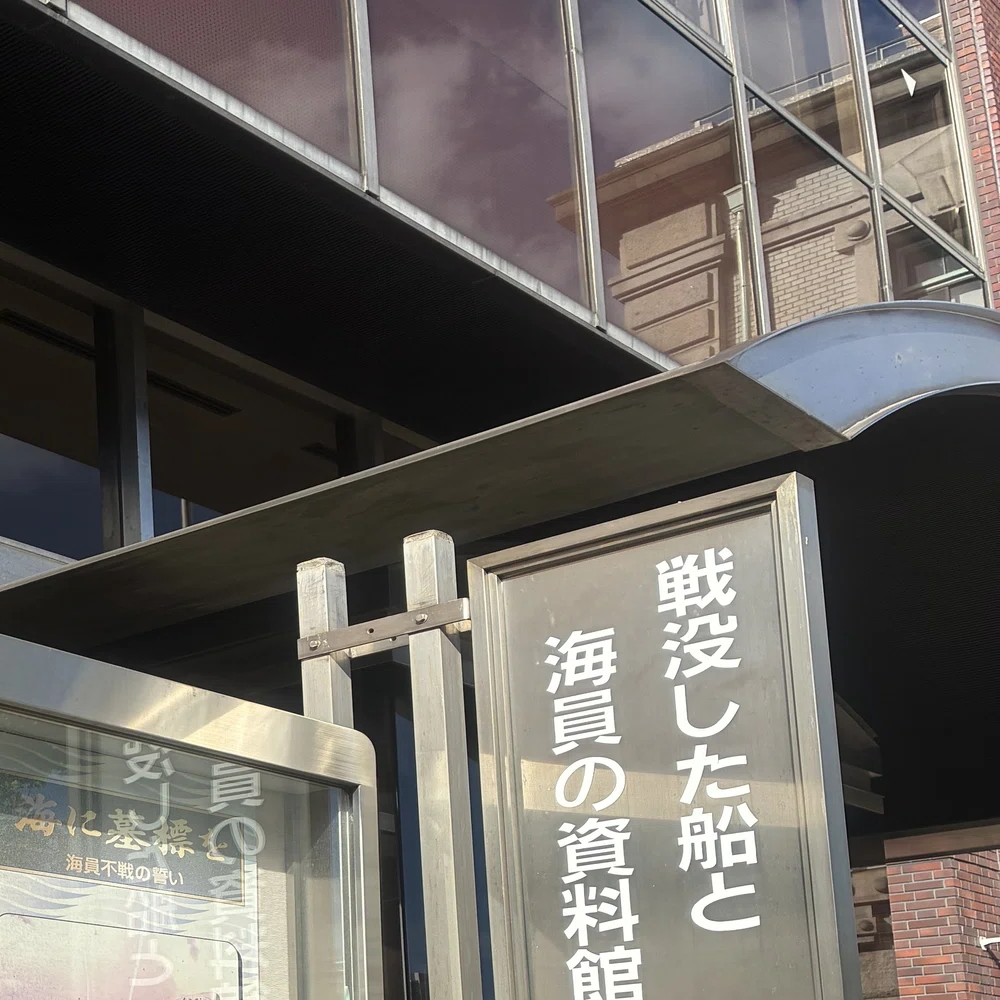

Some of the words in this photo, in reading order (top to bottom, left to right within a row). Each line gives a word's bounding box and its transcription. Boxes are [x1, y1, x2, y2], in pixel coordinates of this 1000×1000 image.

[656, 546, 760, 931] 戦没した船と
[65, 853, 184, 886] 海員不戦の誓い
